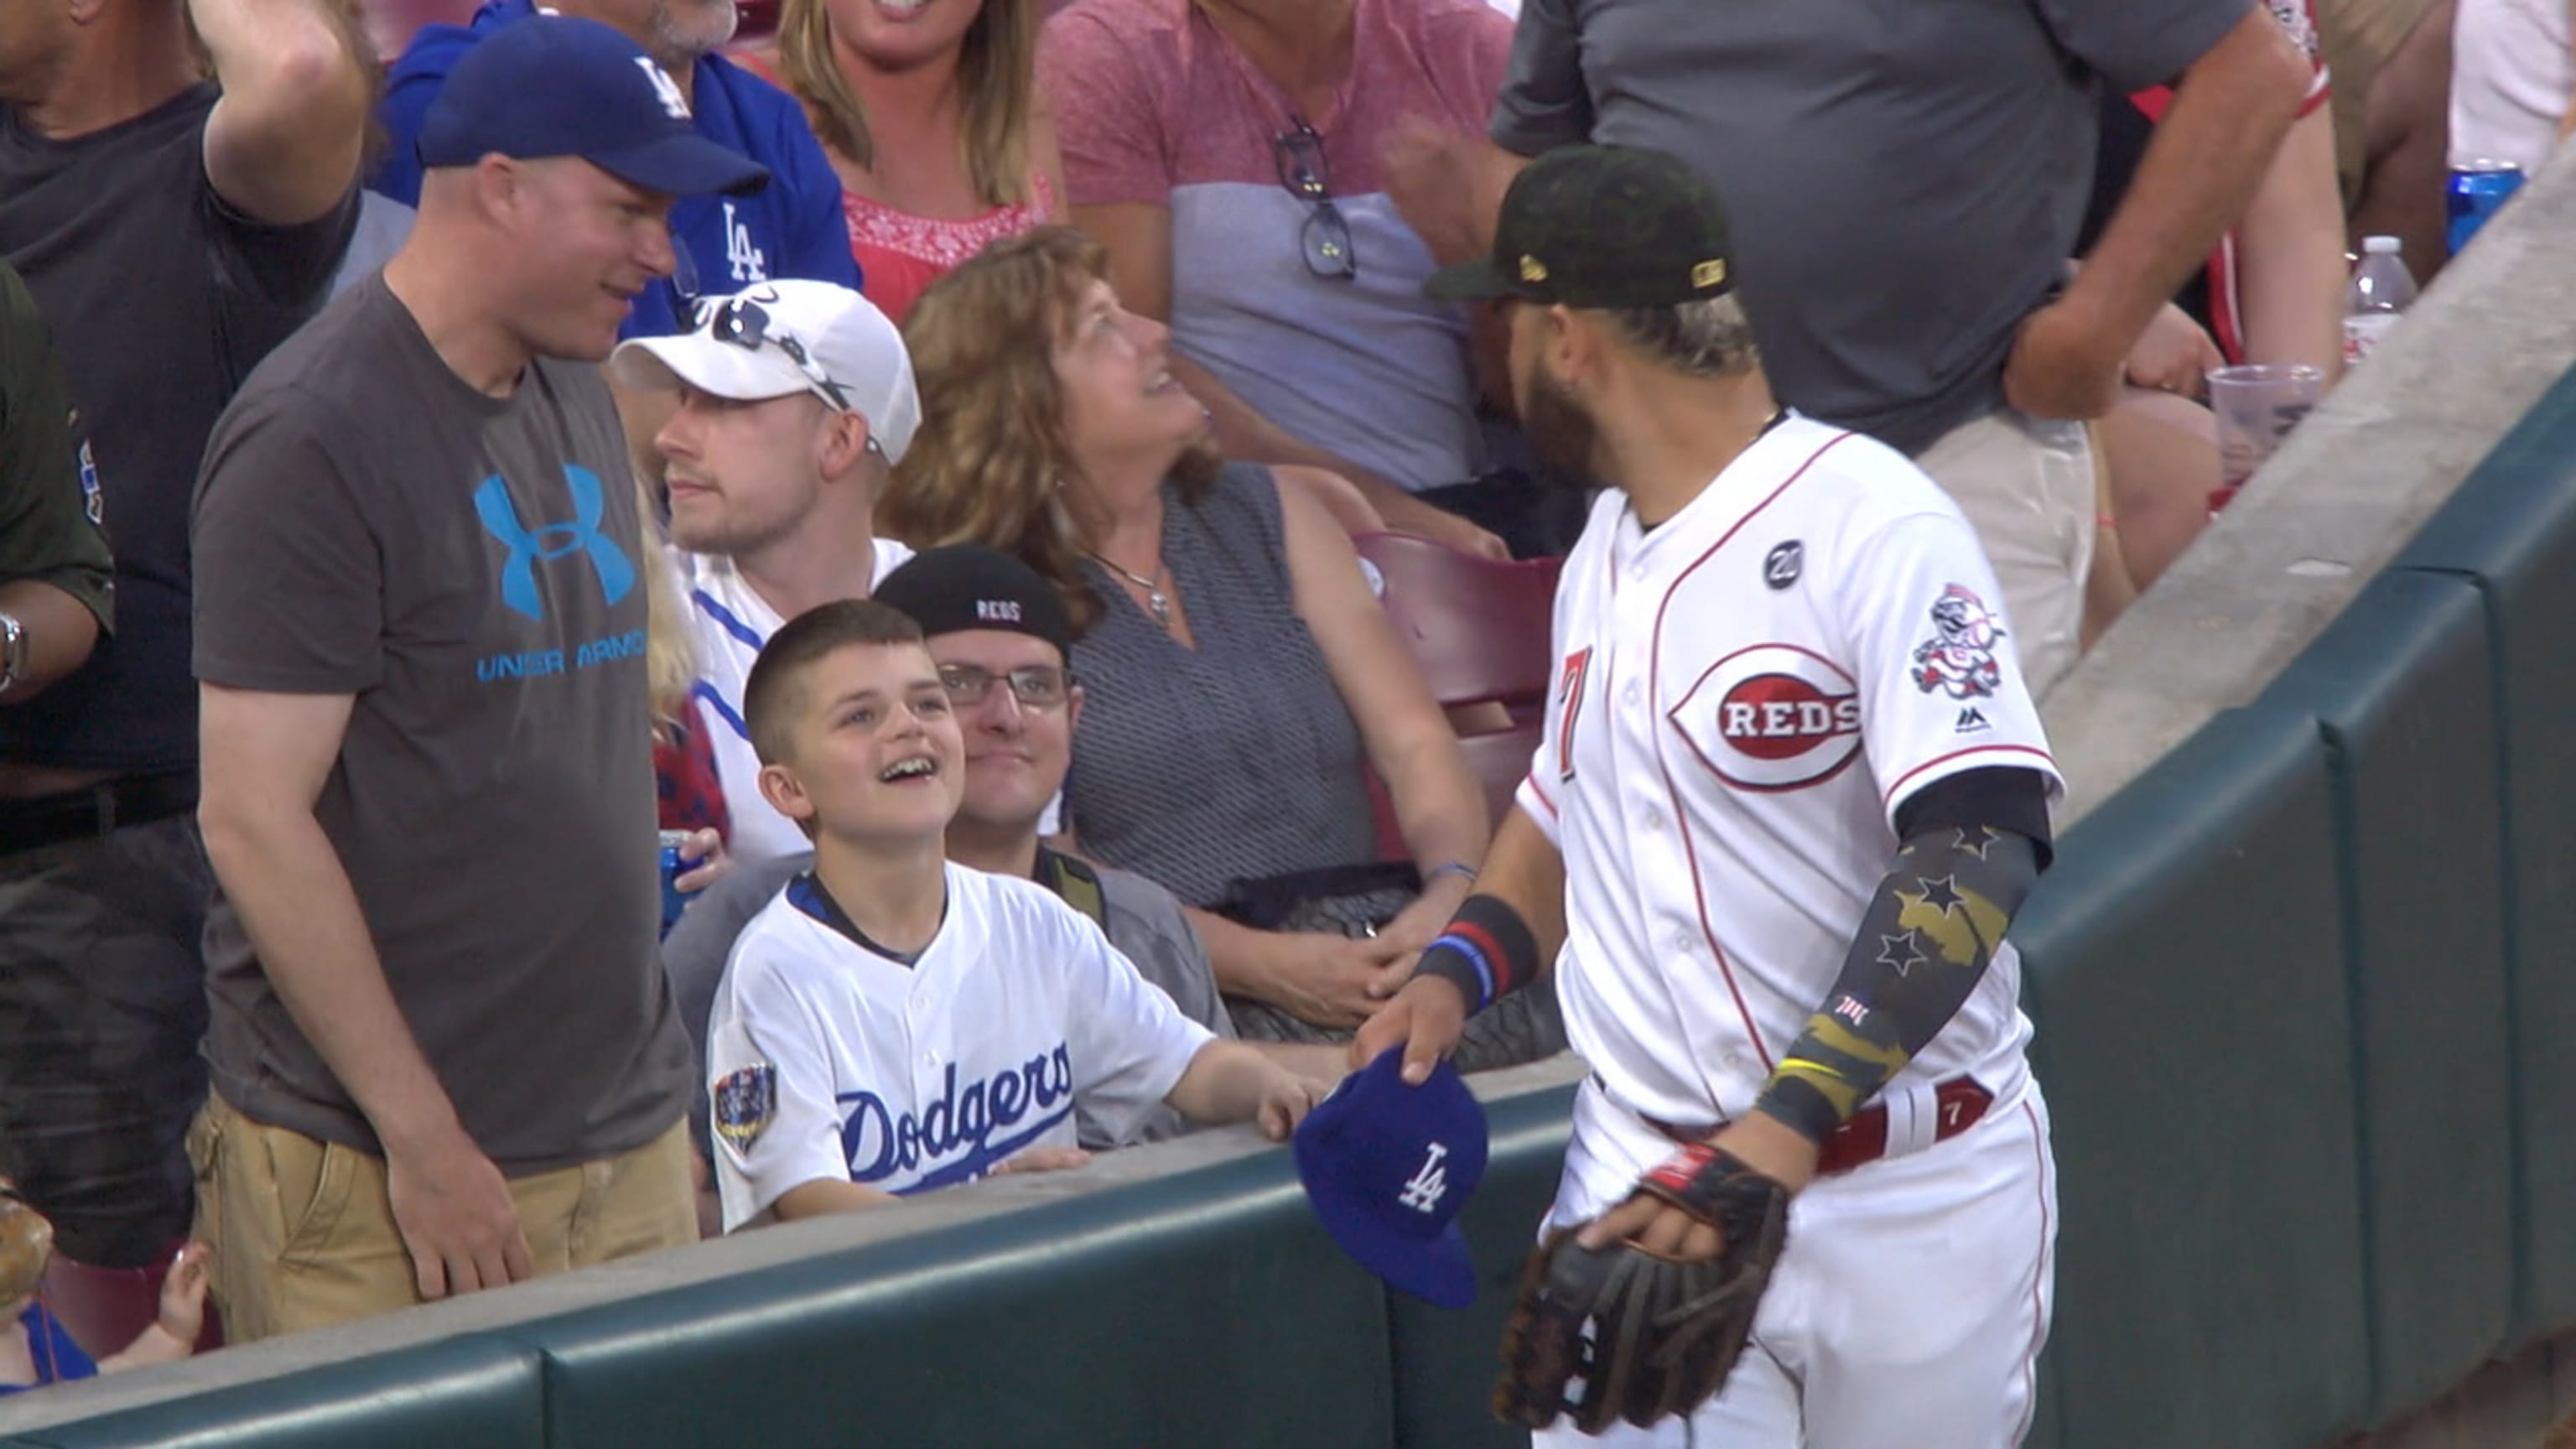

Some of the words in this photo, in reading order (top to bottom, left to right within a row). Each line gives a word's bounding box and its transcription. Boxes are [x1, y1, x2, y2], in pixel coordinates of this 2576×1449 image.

[723, 202, 766, 281] LA
[1560, 645, 1593, 784] 7
[1724, 698, 1860, 737] REDS
[835, 1040, 1072, 1183] Dodgers
[1944, 1100, 1962, 1125] 7
[1398, 1142, 1447, 1213] LA
